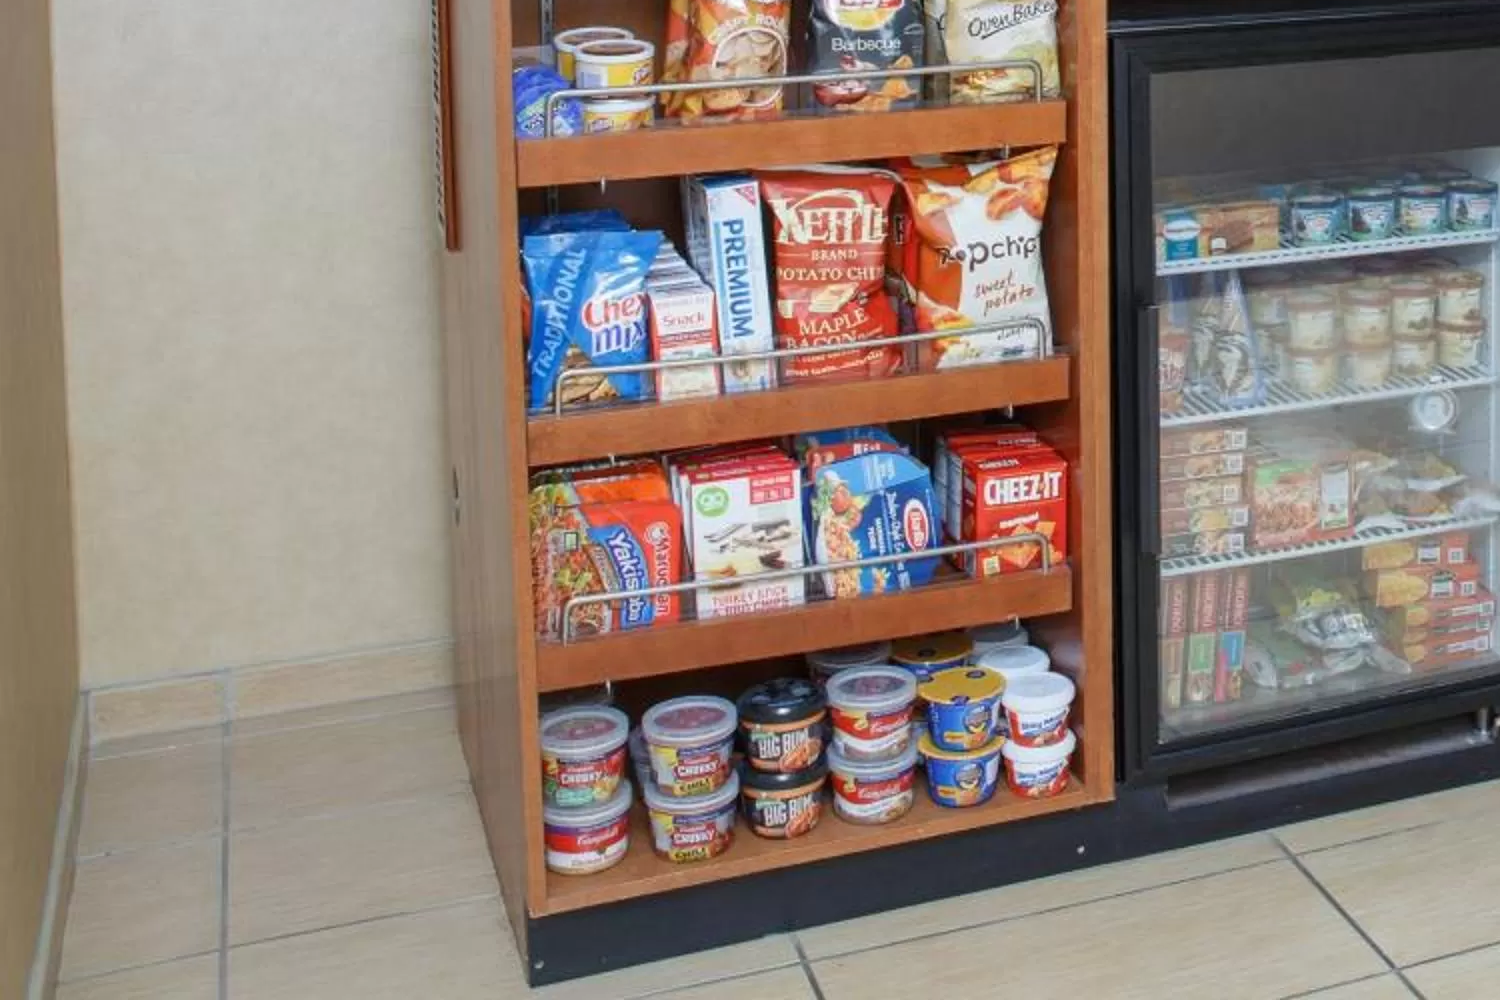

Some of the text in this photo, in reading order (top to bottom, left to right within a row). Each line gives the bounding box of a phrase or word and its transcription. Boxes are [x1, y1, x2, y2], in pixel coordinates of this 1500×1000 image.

[830, 37, 902, 52] Barbecue
[811, 248, 858, 262] BRAND
[722, 218, 756, 338] PREMIUM
[777, 265, 842, 282] POTATO
[532, 248, 587, 378] TRADITIONAL
[662, 311, 706, 328] Snack
[798, 307, 869, 336] MAPLE
[983, 471, 1064, 506] CHEEZ-IT
[654, 534, 672, 617] Marucan
[758, 736, 782, 760] BIG
[763, 804, 788, 828] BIG
